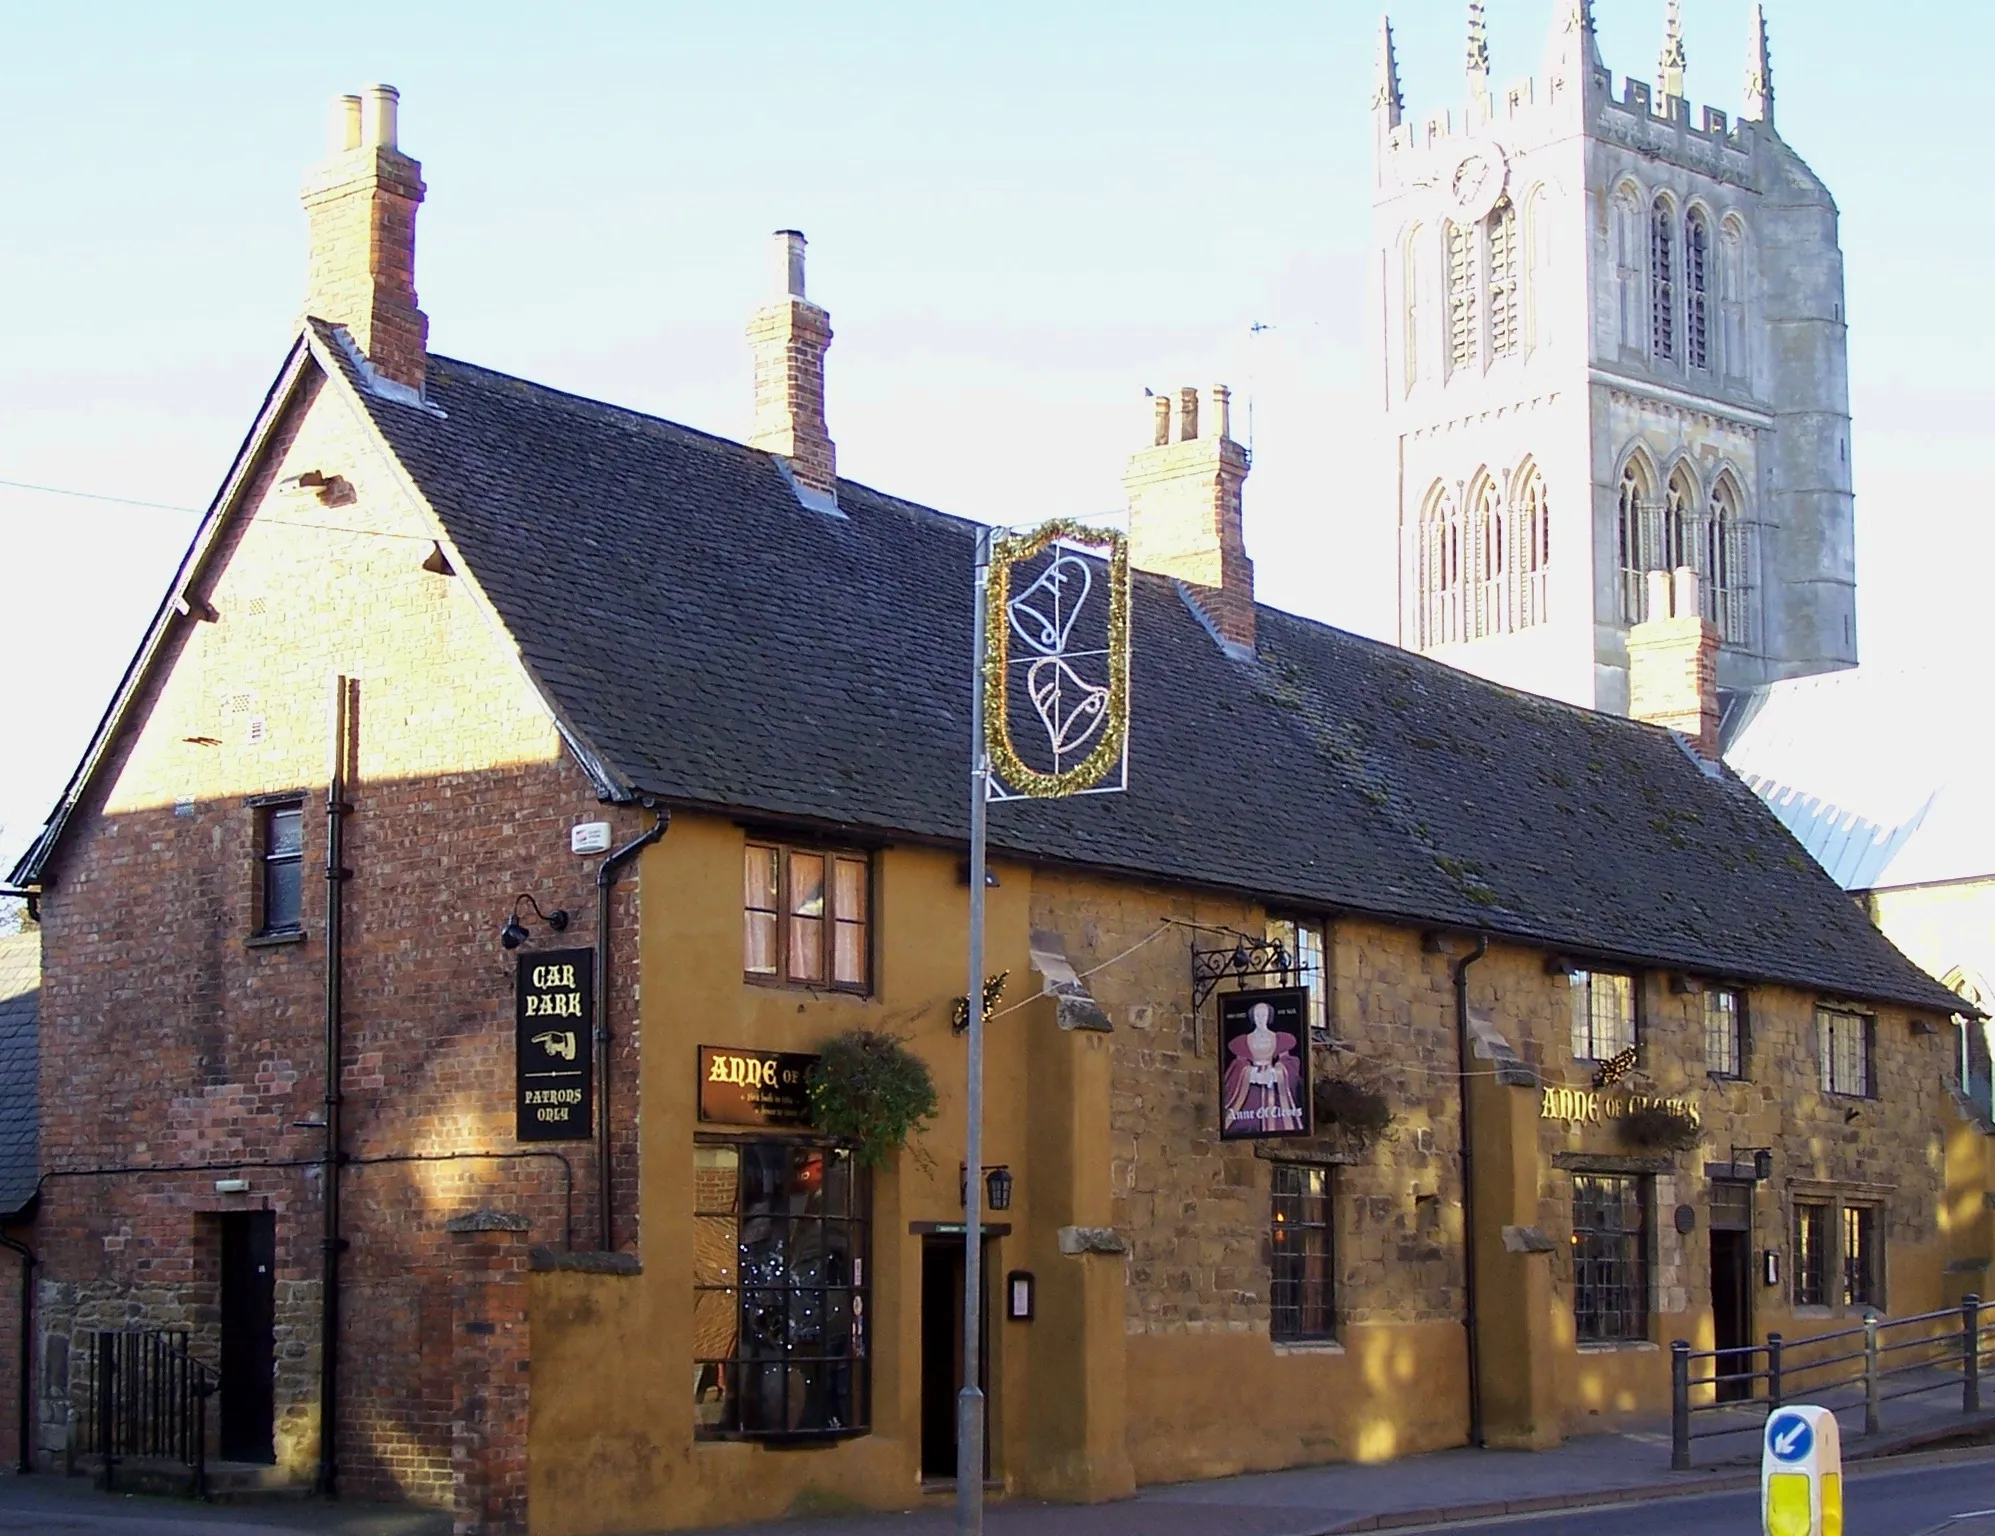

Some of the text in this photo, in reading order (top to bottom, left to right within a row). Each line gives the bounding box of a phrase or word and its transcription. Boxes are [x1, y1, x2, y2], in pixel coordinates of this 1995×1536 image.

[532, 964, 576, 989] CAR
[525, 992, 582, 1018] PARK
[708, 1055, 779, 1088] ANNE
[783, 1070, 799, 1084] OF
[525, 1088, 582, 1105] PATRONS
[1540, 1085, 1601, 1128] ANNE
[1605, 1097, 1622, 1118] OF
[537, 1107, 569, 1123] ONLY
